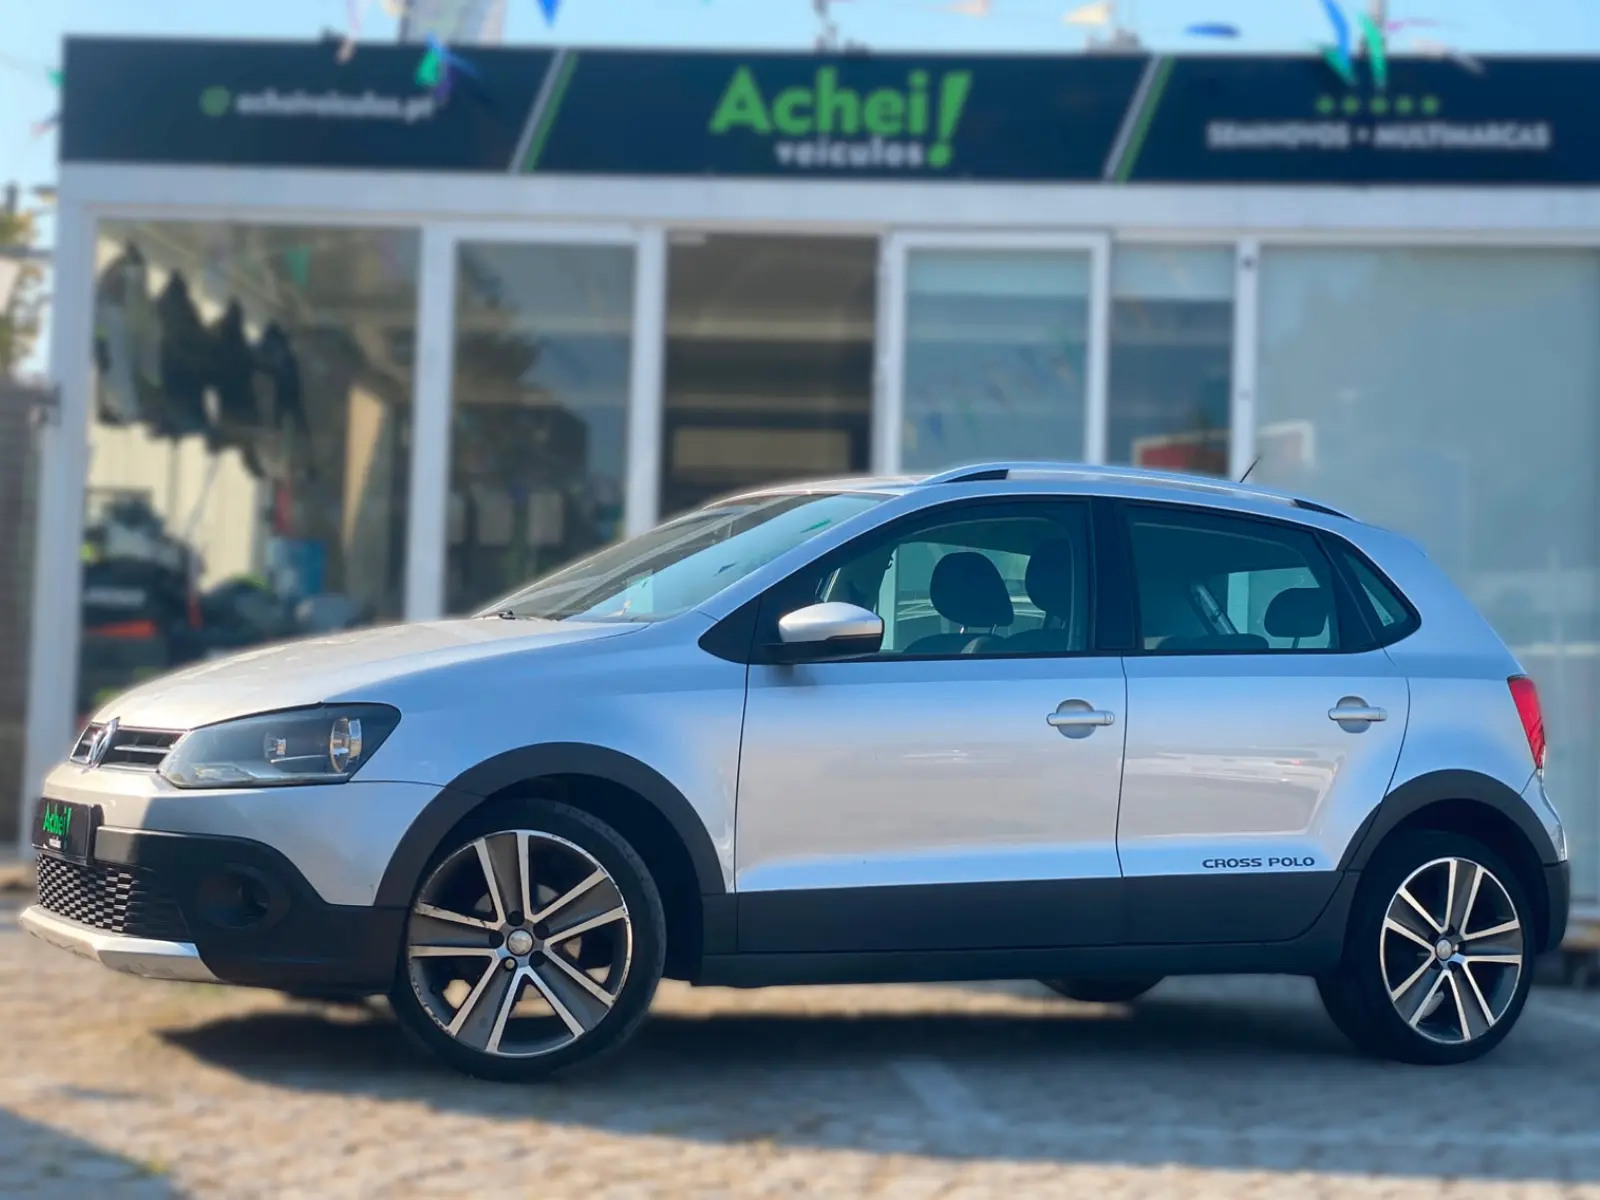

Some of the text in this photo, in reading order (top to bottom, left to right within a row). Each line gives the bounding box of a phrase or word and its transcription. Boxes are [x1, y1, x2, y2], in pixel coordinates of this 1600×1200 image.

[709, 65, 972, 167] Achei!
[1202, 856, 1315, 868] CROSS POLO
